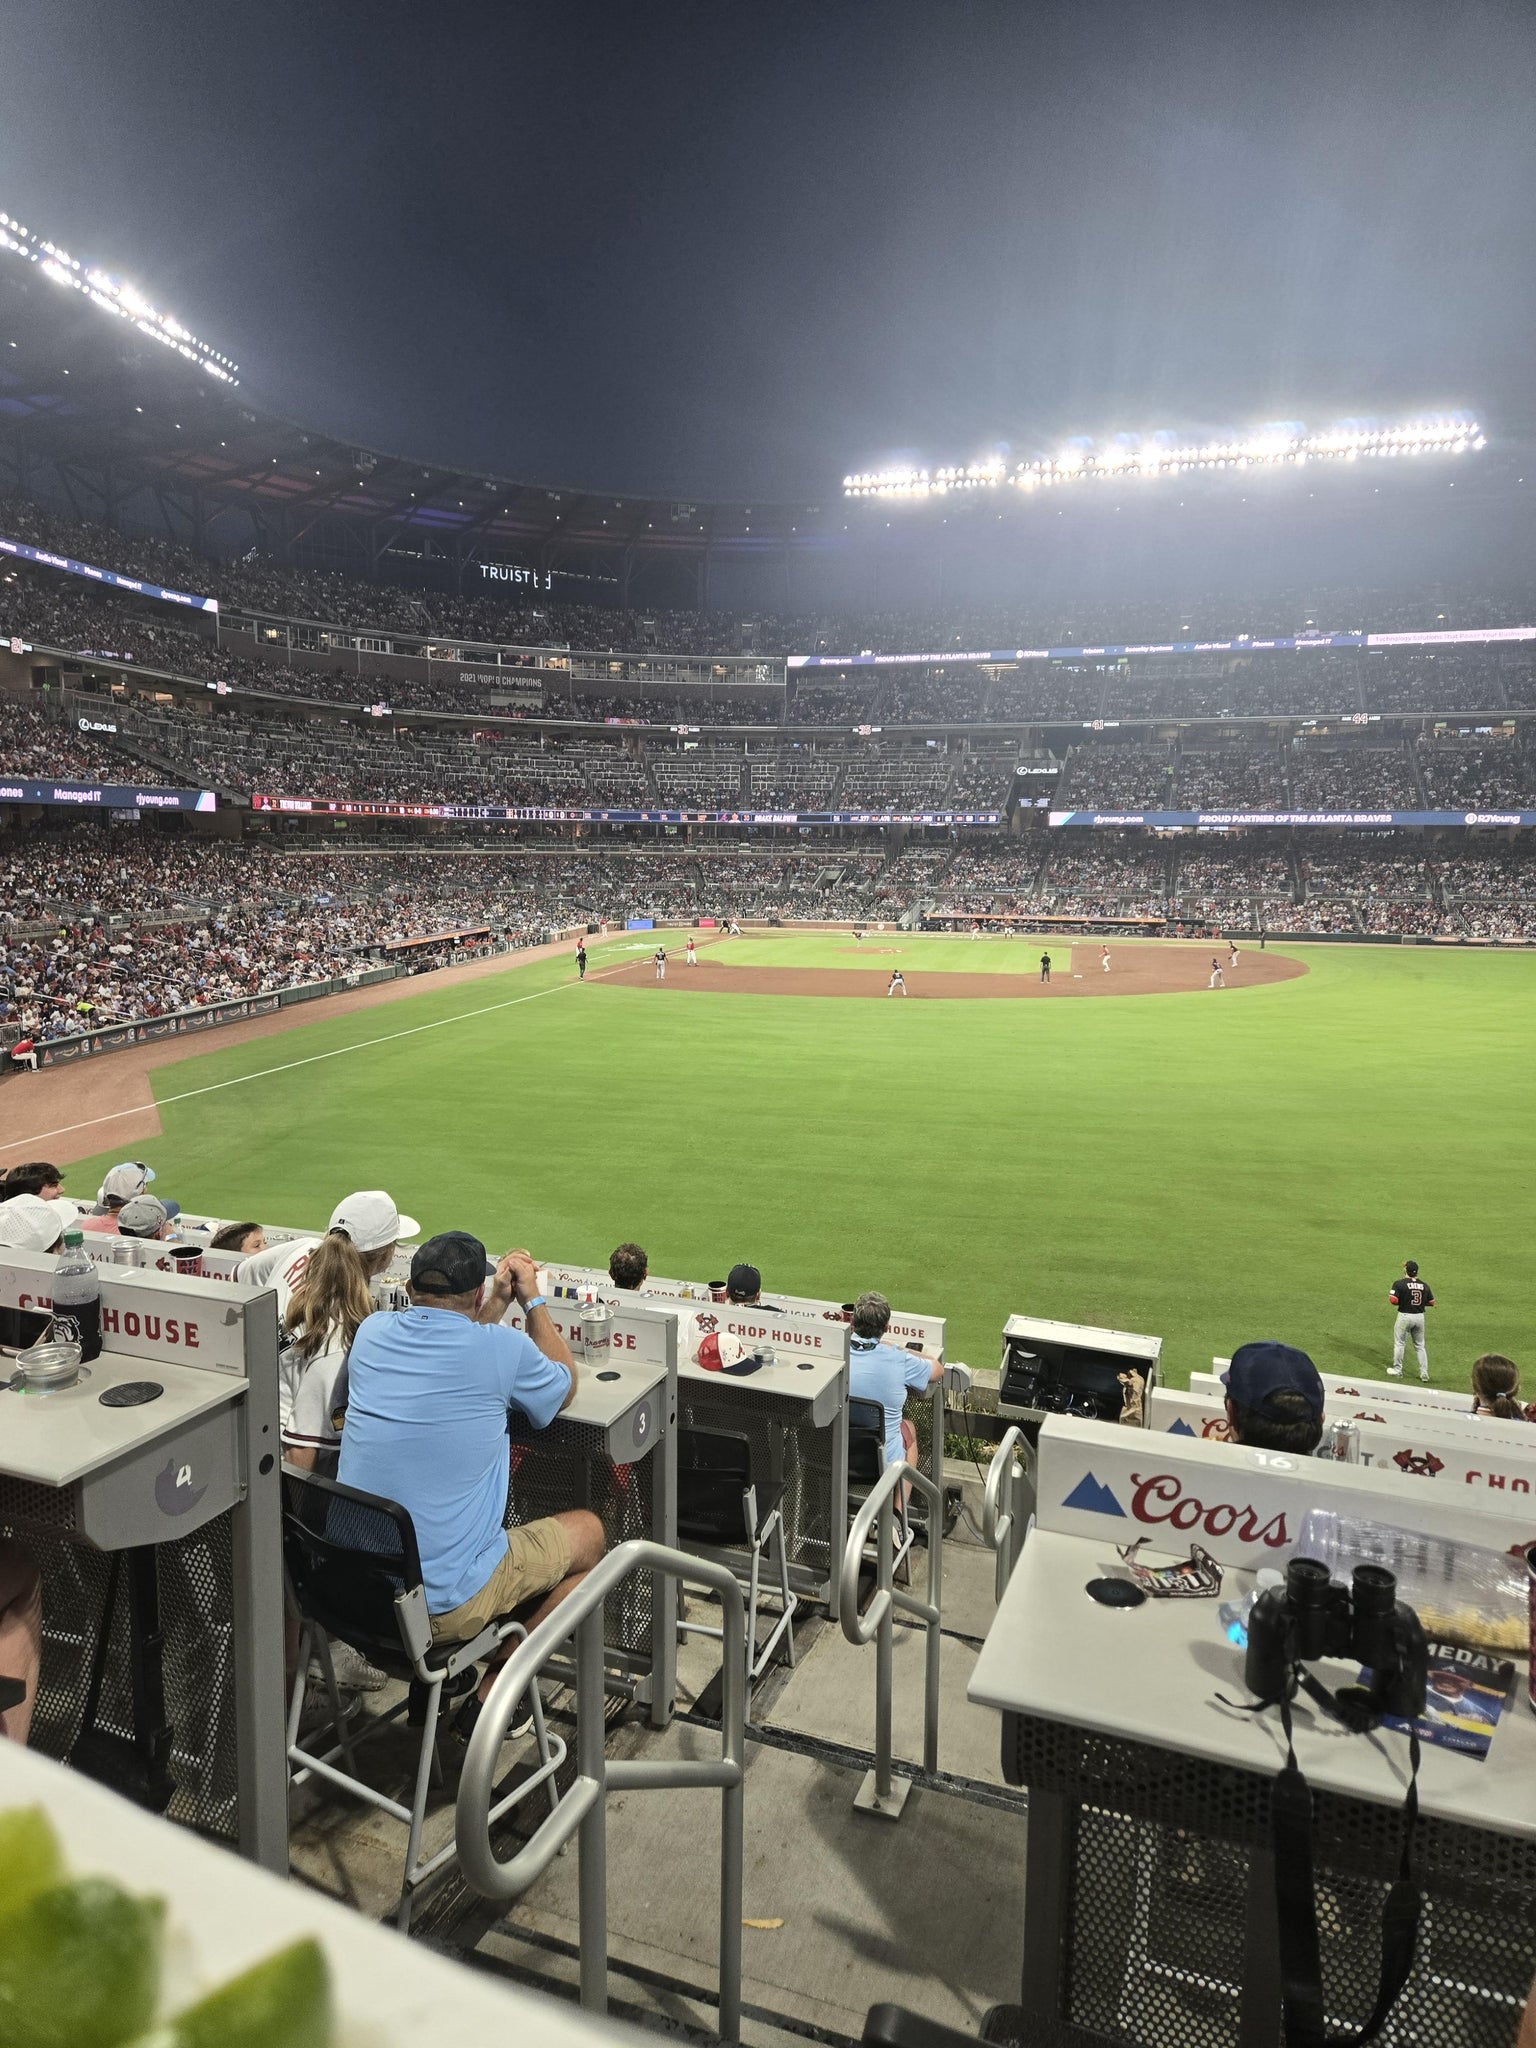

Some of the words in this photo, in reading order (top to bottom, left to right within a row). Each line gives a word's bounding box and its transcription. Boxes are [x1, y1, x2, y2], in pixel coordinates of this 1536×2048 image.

[480, 565, 530, 583] TRUIST
[1375, 635, 1412, 643] Technology
[875, 655, 895, 663] PROUD
[895, 654, 921, 662] PARTNER
[922, 653, 930, 661] OF
[941, 652, 968, 660] ATLANTA
[460, 672, 476, 683] 2021
[501, 676, 542, 688] CHAMPIONS
[1091, 719, 1104, 730] 41
[1352, 712, 1368, 724] 44
[89, 724, 117, 733] LEXUS
[0, 787, 23, 798] ones
[53, 788, 93, 803] Managed
[93, 791, 101, 802] IT
[136, 793, 179, 807] rjyoung.com
[1093, 815, 1144, 824] rjyoung.com
[1199, 814, 1231, 823] PROUD
[1232, 814, 1275, 823] PARTNER
[1275, 814, 1290, 823] OF
[1290, 814, 1308, 823] THE
[1308, 814, 1353, 823] ATLANTA
[1354, 814, 1392, 823] BRAVES
[1477, 814, 1521, 824] RJYoung
[1410, 1289, 1423, 1306] 3
[103, 1307, 200, 1349] HOUSE
[727, 1322, 767, 1339] CHOP
[771, 1329, 822, 1349] HOUSE
[884, 1324, 925, 1339] HOUSE
[569, 1325, 637, 1351] HSE
[638, 1412, 646, 1434] 3
[1254, 1452, 1293, 1470] 16
[175, 1463, 193, 1487] 4
[1465, 1470, 1536, 1494] CHO
[1130, 1472, 1294, 1548] Coors
[1426, 1642, 1507, 1673] MEDAY
